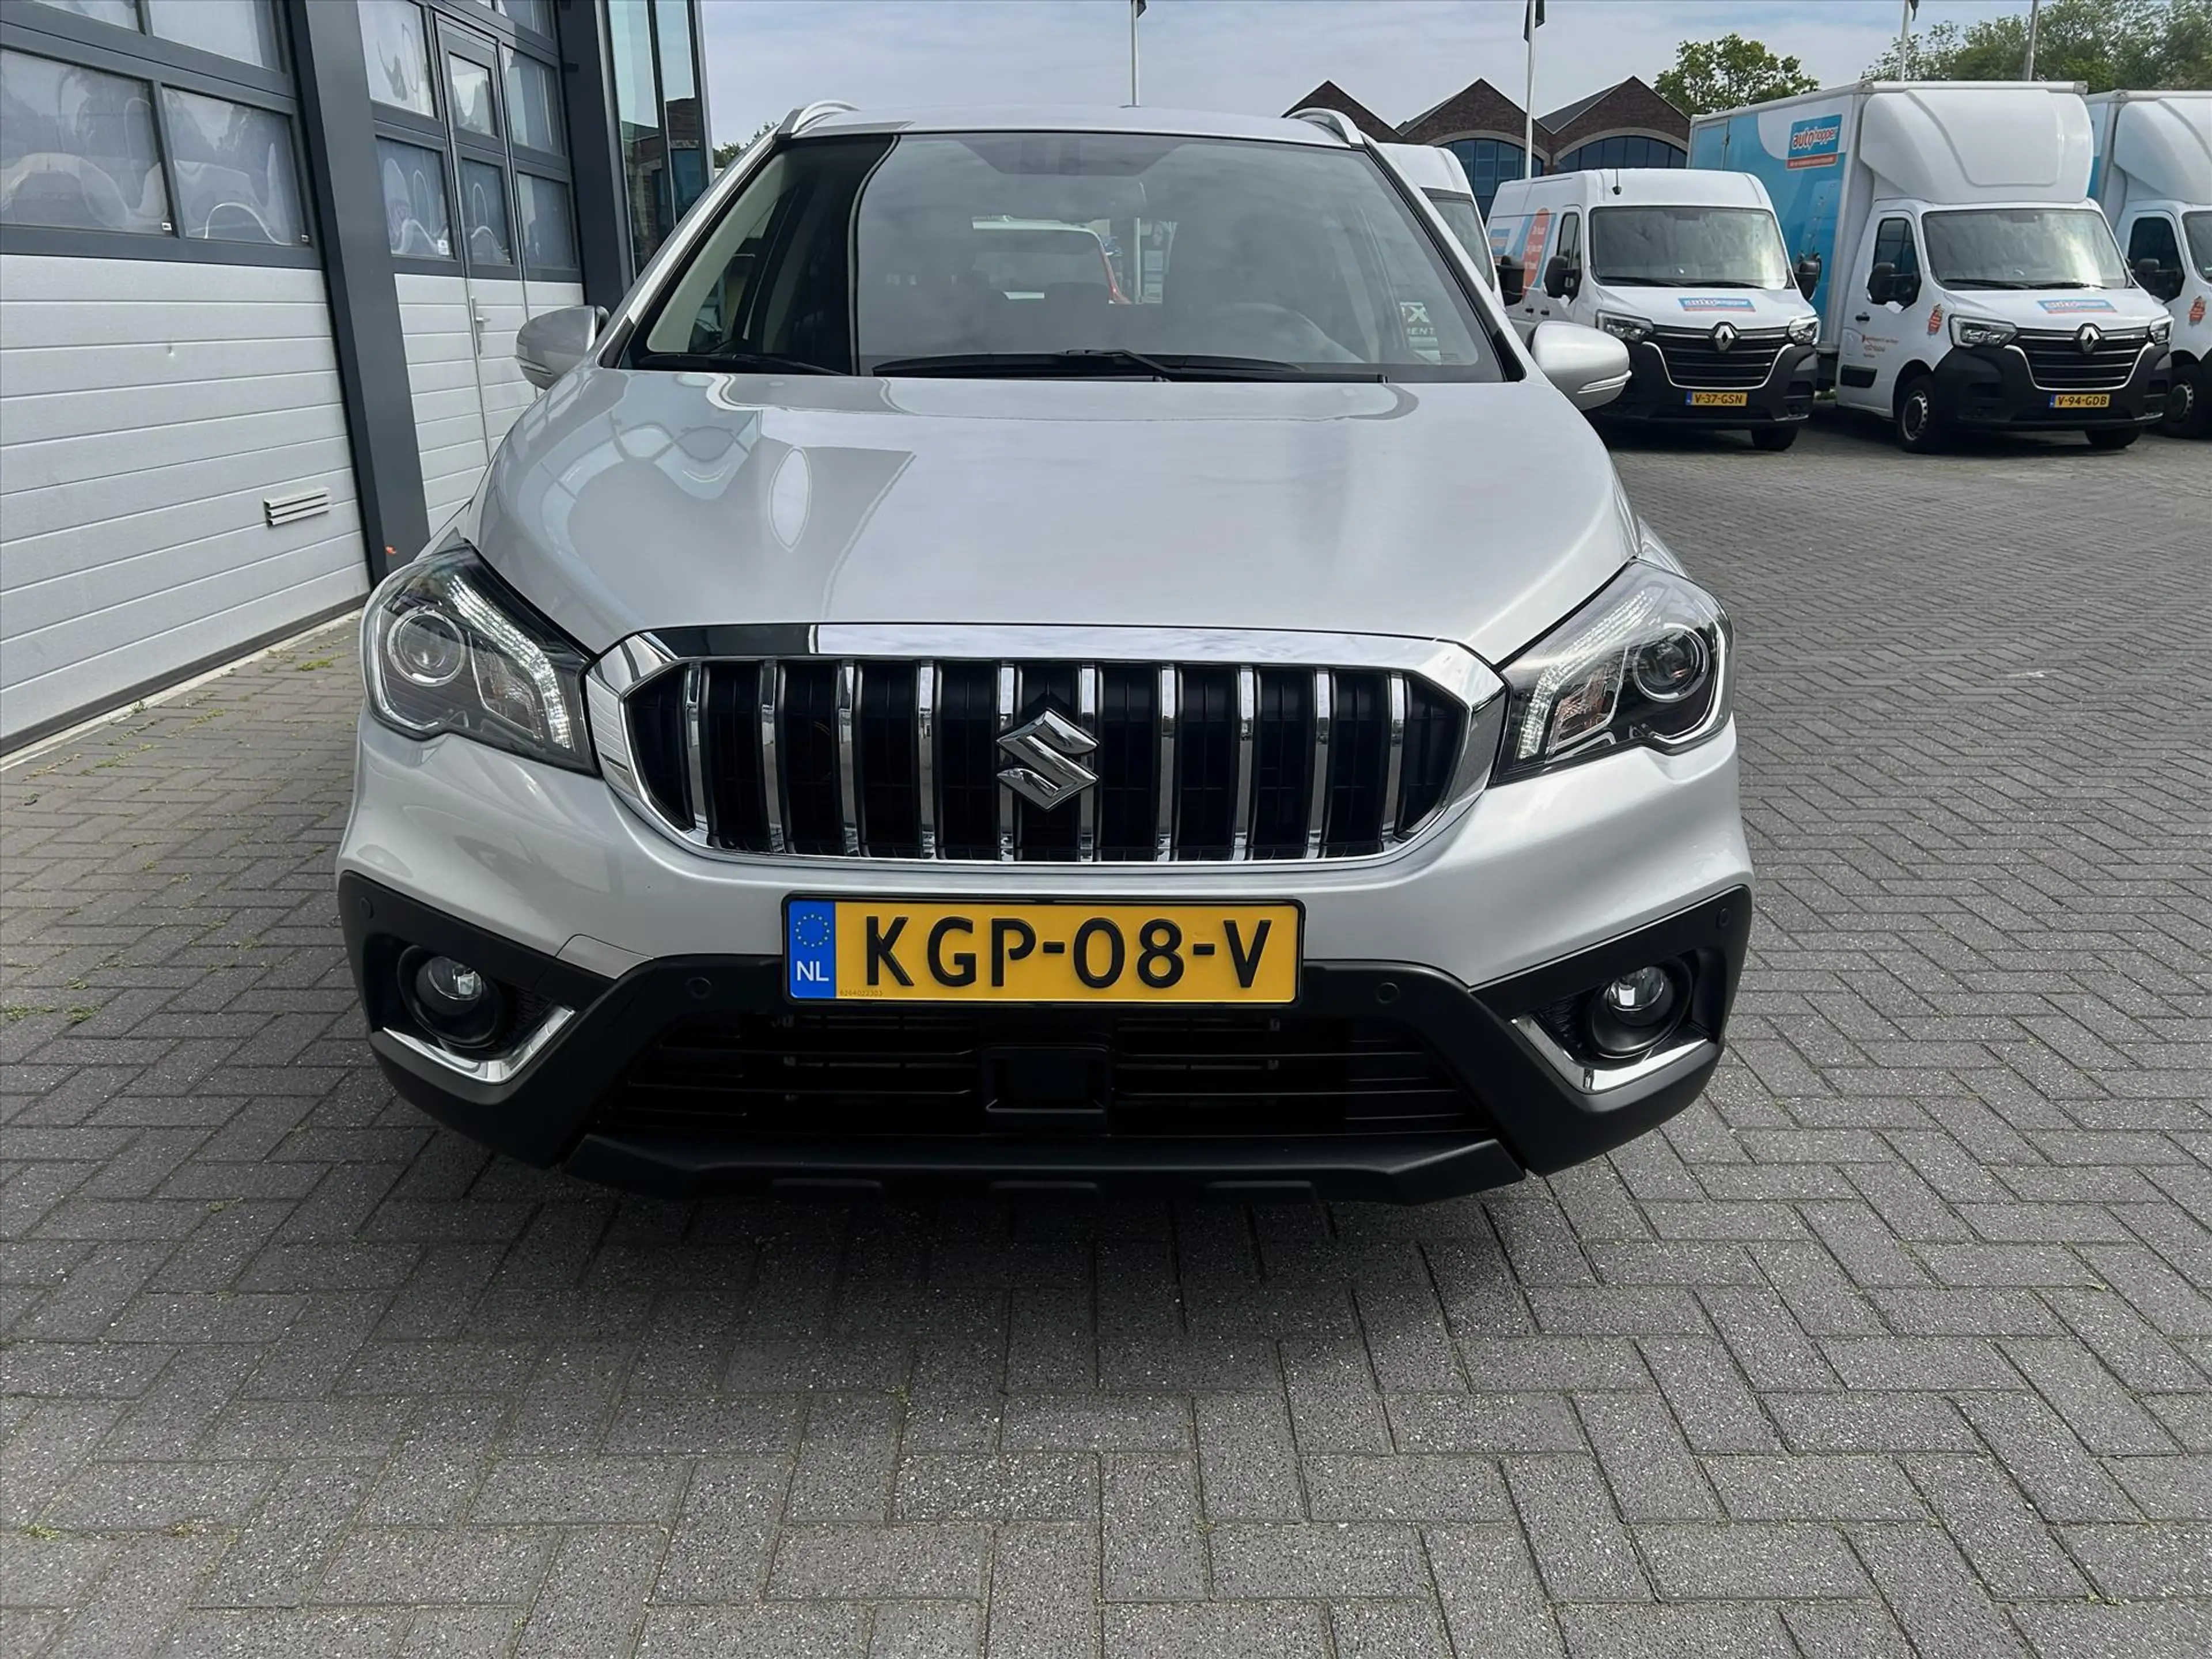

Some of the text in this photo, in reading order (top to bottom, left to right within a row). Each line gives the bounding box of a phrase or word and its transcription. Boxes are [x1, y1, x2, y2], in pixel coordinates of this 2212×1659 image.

[1694, 393, 1743, 404] V-37-GSN
[2058, 396, 2107, 406] V-94-GDB
[866, 916, 1272, 988] KGP-08-V
[797, 960, 830, 982] NL
